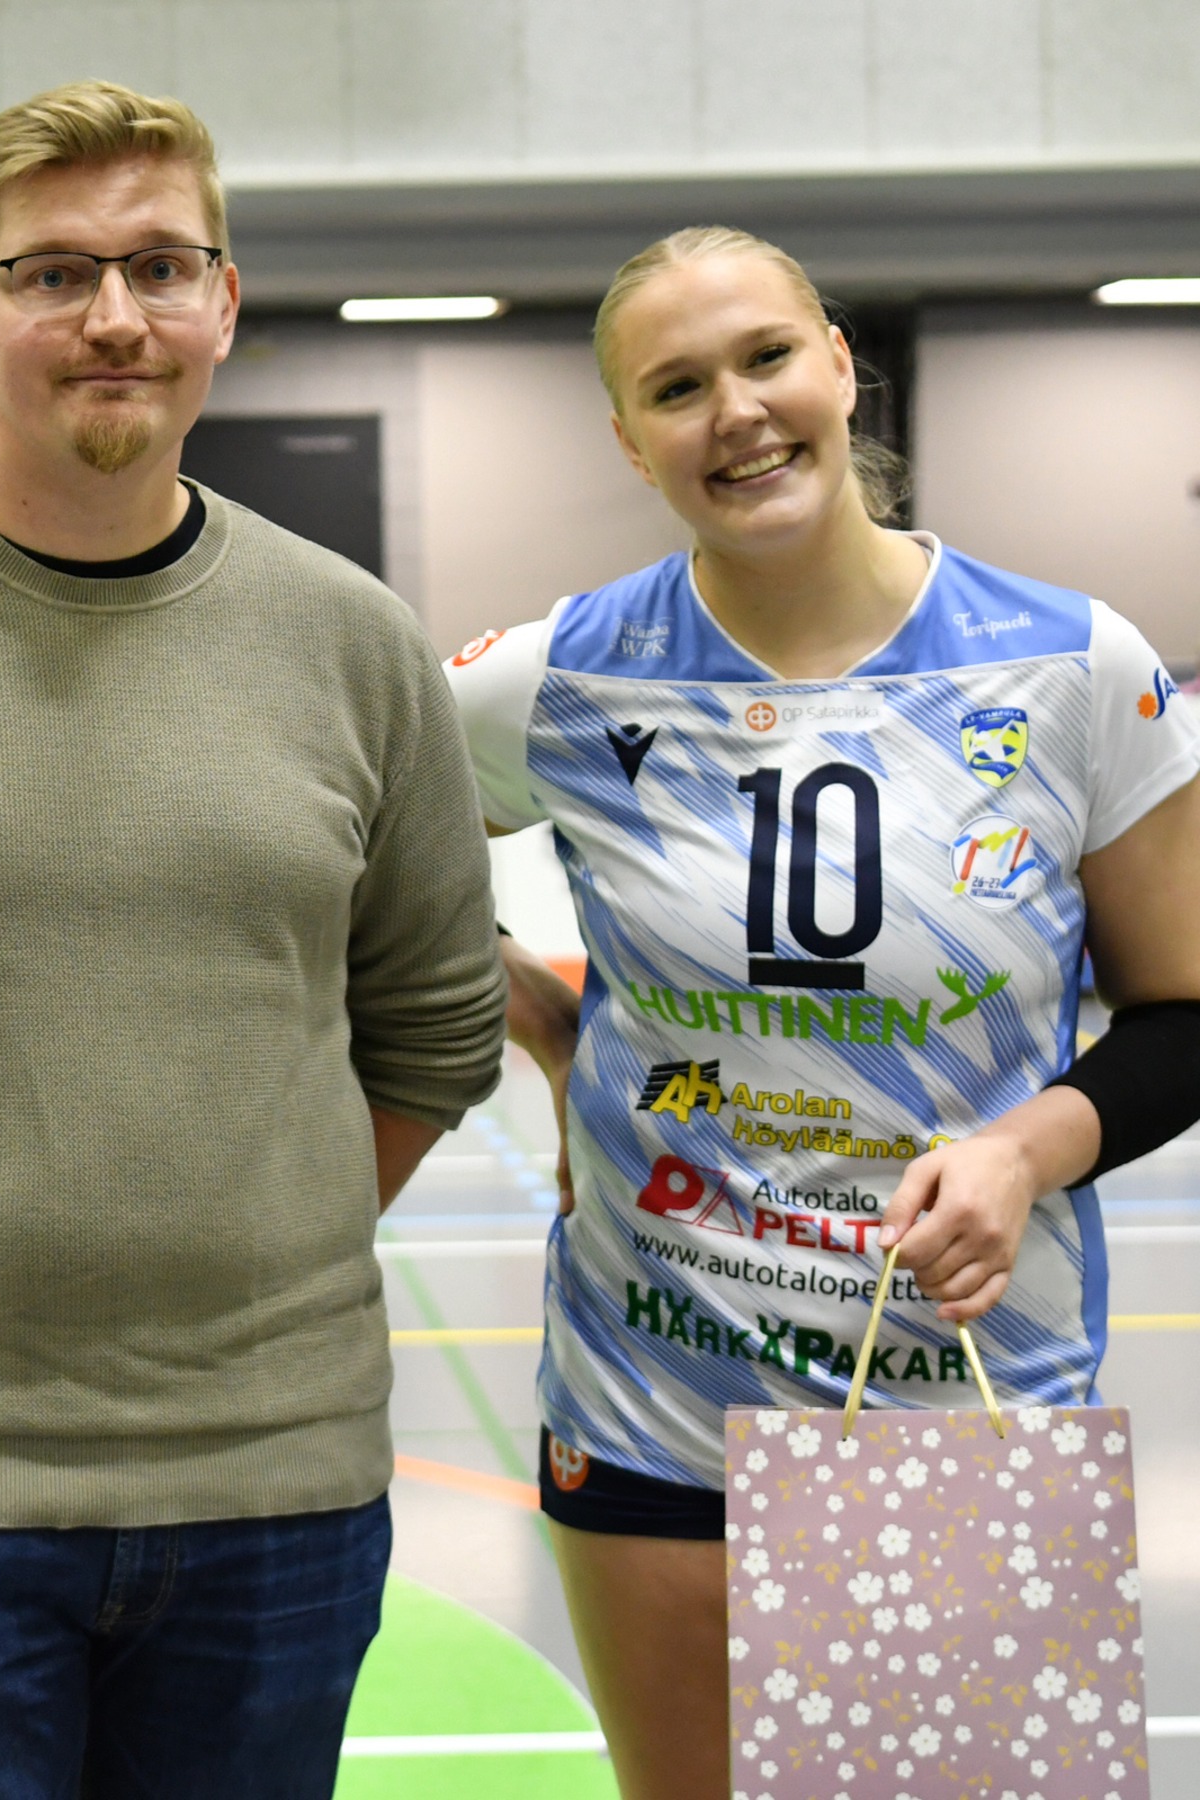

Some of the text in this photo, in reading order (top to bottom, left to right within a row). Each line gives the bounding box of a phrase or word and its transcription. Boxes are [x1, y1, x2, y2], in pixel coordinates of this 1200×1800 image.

[781, 704, 879, 723] OP Satapirkka
[737, 760, 884, 960] 10
[628, 980, 931, 1046] HUITTINEN
[730, 1081, 852, 1119] Arolan
[732, 1114, 917, 1160] Höyläämö
[751, 1178, 878, 1212] Autotalo
[752, 1206, 881, 1254] PELT
